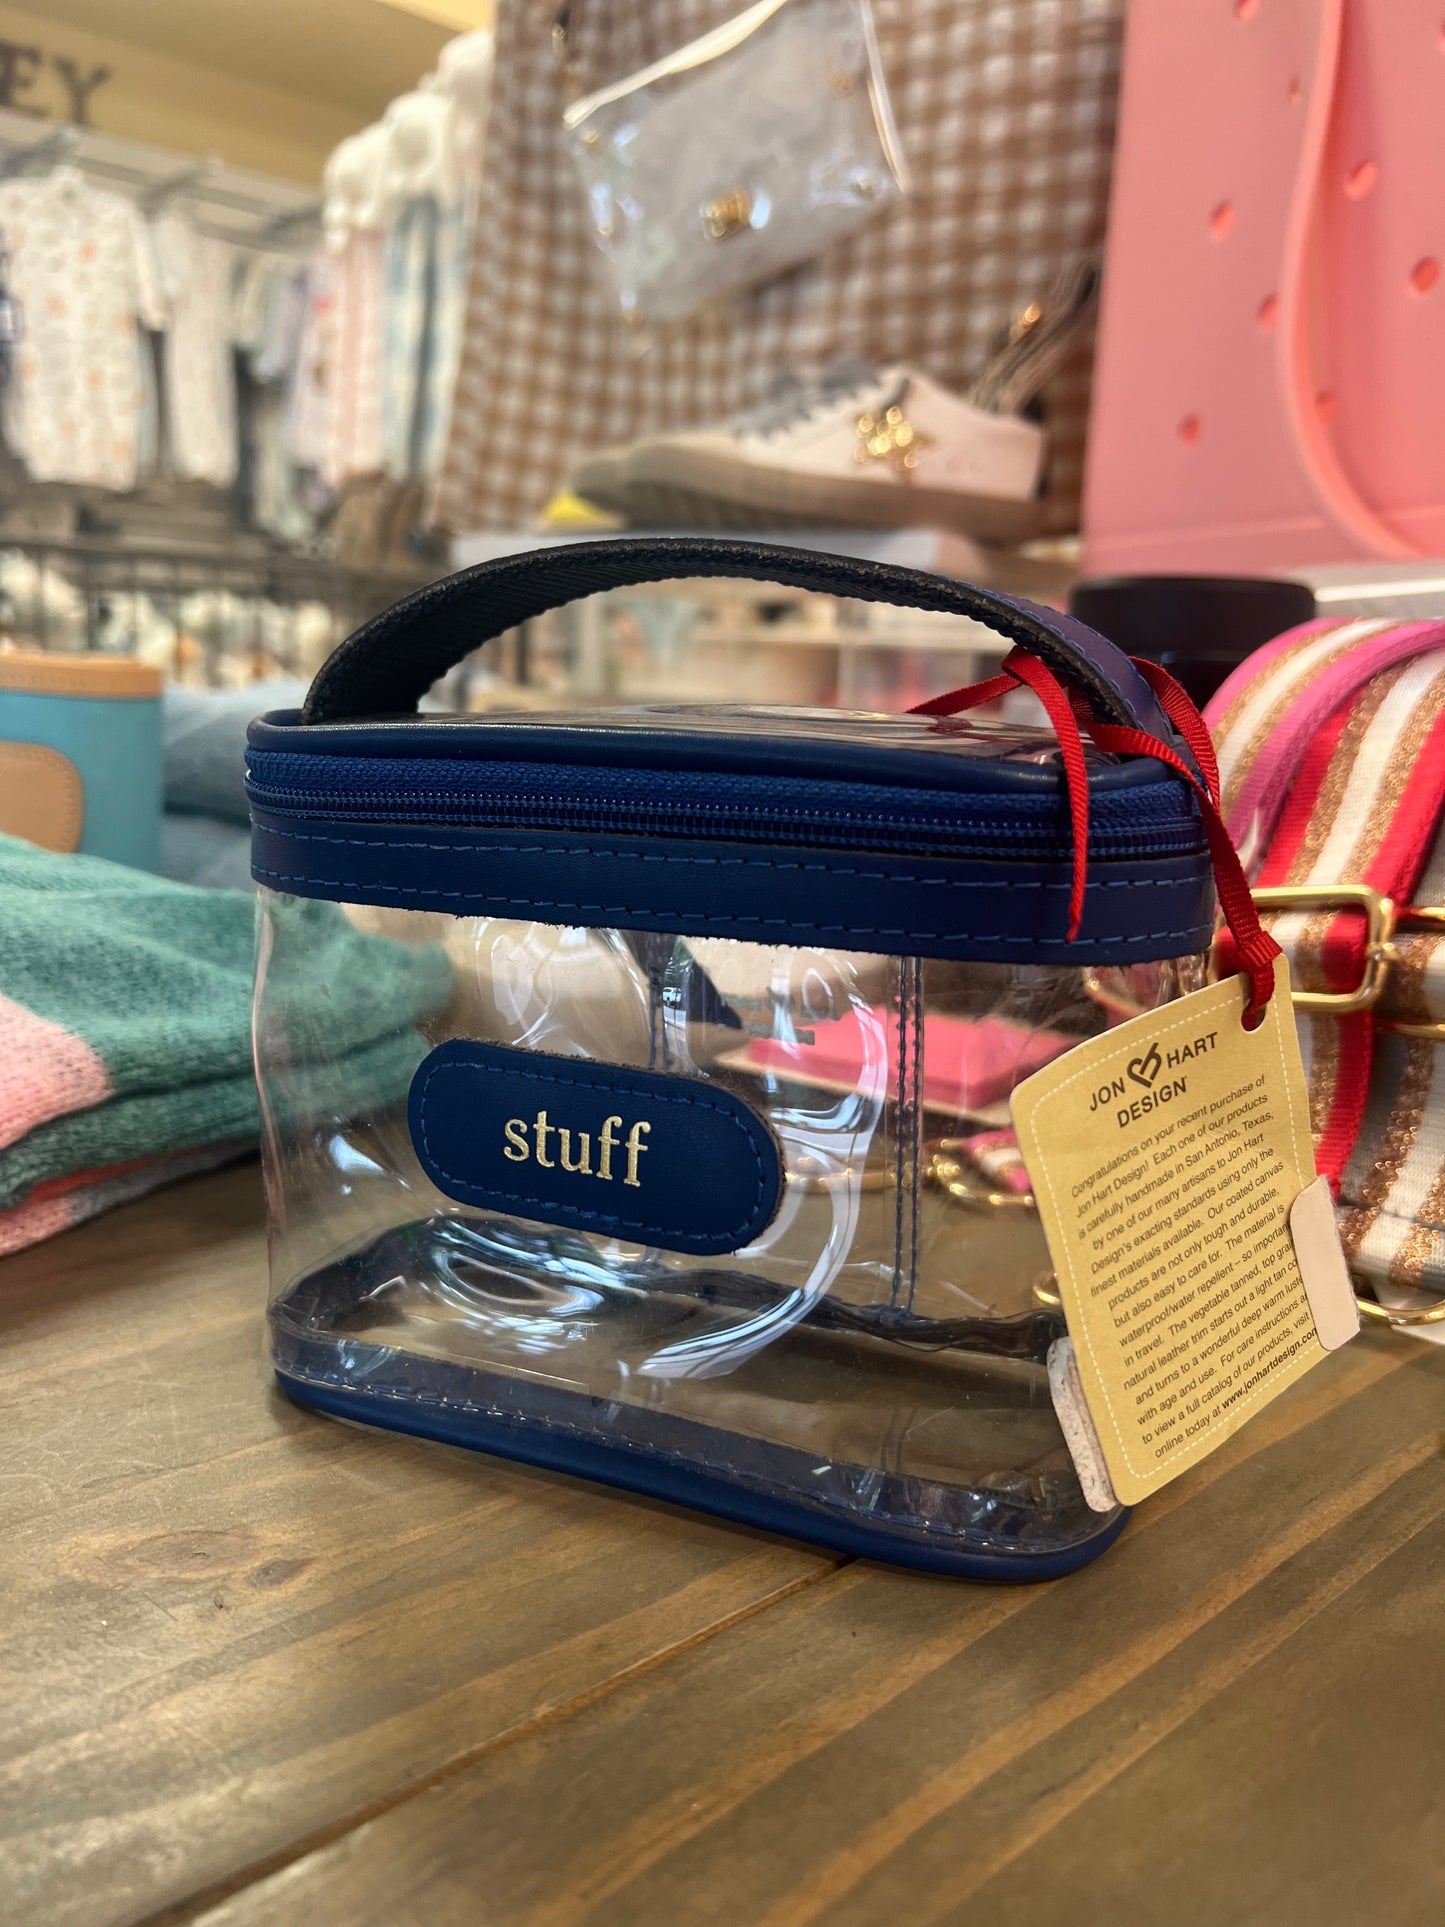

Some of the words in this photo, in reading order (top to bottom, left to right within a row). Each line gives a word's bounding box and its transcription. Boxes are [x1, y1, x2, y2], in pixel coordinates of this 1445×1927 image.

[1090, 1077, 1126, 1112] JON
[1166, 1031, 1218, 1069] HART
[1117, 1076, 1187, 1128] DESIGN
[503, 1110, 651, 1187] stuff
[1071, 1145, 1139, 1198] Congratulations
[1140, 1137, 1153, 1150] on
[1153, 1123, 1174, 1144] your
[1176, 1105, 1207, 1128] recent
[1209, 1082, 1253, 1114] purchase
[1255, 1073, 1264, 1087] of
[1076, 1200, 1091, 1218] Jon
[1091, 1184, 1112, 1205] Hart
[1152, 1144, 1177, 1165] Each
[1177, 1133, 1195, 1149] one
[1196, 1123, 1206, 1137] of
[1207, 1116, 1224, 1131] our
[1226, 1094, 1267, 1124] products
[1078, 1228, 1086, 1239] is
[1086, 1200, 1123, 1232] carefully
[1124, 1169, 1174, 1206] handmade
[1174, 1162, 1184, 1174] in
[1184, 1150, 1204, 1167] San
[1092, 1236, 1103, 1250] by
[1105, 1223, 1124, 1241] one
[1125, 1213, 1136, 1228] of
[1137, 1204, 1152, 1221] our
[1154, 1187, 1179, 1210] many
[1181, 1164, 1216, 1192] artisans
[1216, 1158, 1225, 1169] to
[1227, 1146, 1242, 1162] Jon
[1243, 1132, 1263, 1151] Hart
[1090, 1273, 1117, 1297] finest
[1117, 1246, 1161, 1279] materials
[1207, 1202, 1223, 1219] Our
[1225, 1179, 1254, 1207] coated
[1254, 1161, 1283, 1187] canvas
[1133, 1216, 1172, 1246] exacting
[1173, 1186, 1216, 1220] standards
[1216, 1170, 1240, 1190] using
[1241, 1156, 1258, 1174] only
[1258, 1148, 1273, 1161] the
[1196, 1262, 1233, 1295] repellent
[1241, 1249, 1252, 1262] so
[1252, 1218, 1291, 1253] importan
[1107, 1276, 1149, 1311] products
[1150, 1265, 1166, 1280] are
[1167, 1252, 1183, 1269] not
[1183, 1239, 1201, 1258] only
[1203, 1222, 1228, 1244] tough
[1229, 1207, 1246, 1227] and
[1112, 1310, 1131, 1328] but
[1131, 1297, 1152, 1316] also
[1153, 1281, 1175, 1301] easy
[1176, 1274, 1187, 1286] to
[1187, 1260, 1207, 1278] care
[1224, 1234, 1242, 1250] The
[1243, 1207, 1276, 1238] material
[1276, 1204, 1284, 1214] is
[1123, 1355, 1134, 1367] in
[1167, 1319, 1187, 1336] The
[1187, 1288, 1229, 1323] vegetable
[1261, 1253, 1275, 1268] top
[1276, 1237, 1293, 1260] grai
[1123, 1360, 1157, 1390] natural
[1156, 1339, 1189, 1367] leather
[1190, 1326, 1208, 1344] trim
[1209, 1308, 1233, 1330] starts
[1233, 1295, 1248, 1312] out
[1248, 1291, 1255, 1301] a
[1254, 1276, 1273, 1295] light
[1272, 1267, 1286, 1281] tan
[1135, 1384, 1154, 1405] and
[1154, 1369, 1179, 1391] turns
[1180, 1362, 1190, 1373] to
[1191, 1356, 1198, 1366] a
[1199, 1322, 1240, 1360] wonderful
[1241, 1307, 1261, 1328] deep
[1262, 1289, 1284, 1311] warm
[1284, 1272, 1303, 1293] luste
[1136, 1407, 1157, 1425] with
[1159, 1393, 1177, 1411] age
[1178, 1377, 1197, 1397] and
[1219, 1350, 1234, 1367] For
[1236, 1335, 1254, 1354] care
[1254, 1299, 1298, 1339] instructions
[1141, 1432, 1152, 1444] to
[1153, 1416, 1175, 1435] view
[1177, 1410, 1185, 1420] a
[1185, 1397, 1200, 1414] full
[1201, 1375, 1232, 1403] catalog
[1232, 1364, 1241, 1378] of
[1242, 1354, 1255, 1371] our
[1293, 1311, 1309, 1328] visit
[1154, 1433, 1183, 1458] online
[1184, 1413, 1209, 1437] today
[1211, 1405, 1221, 1417] at
